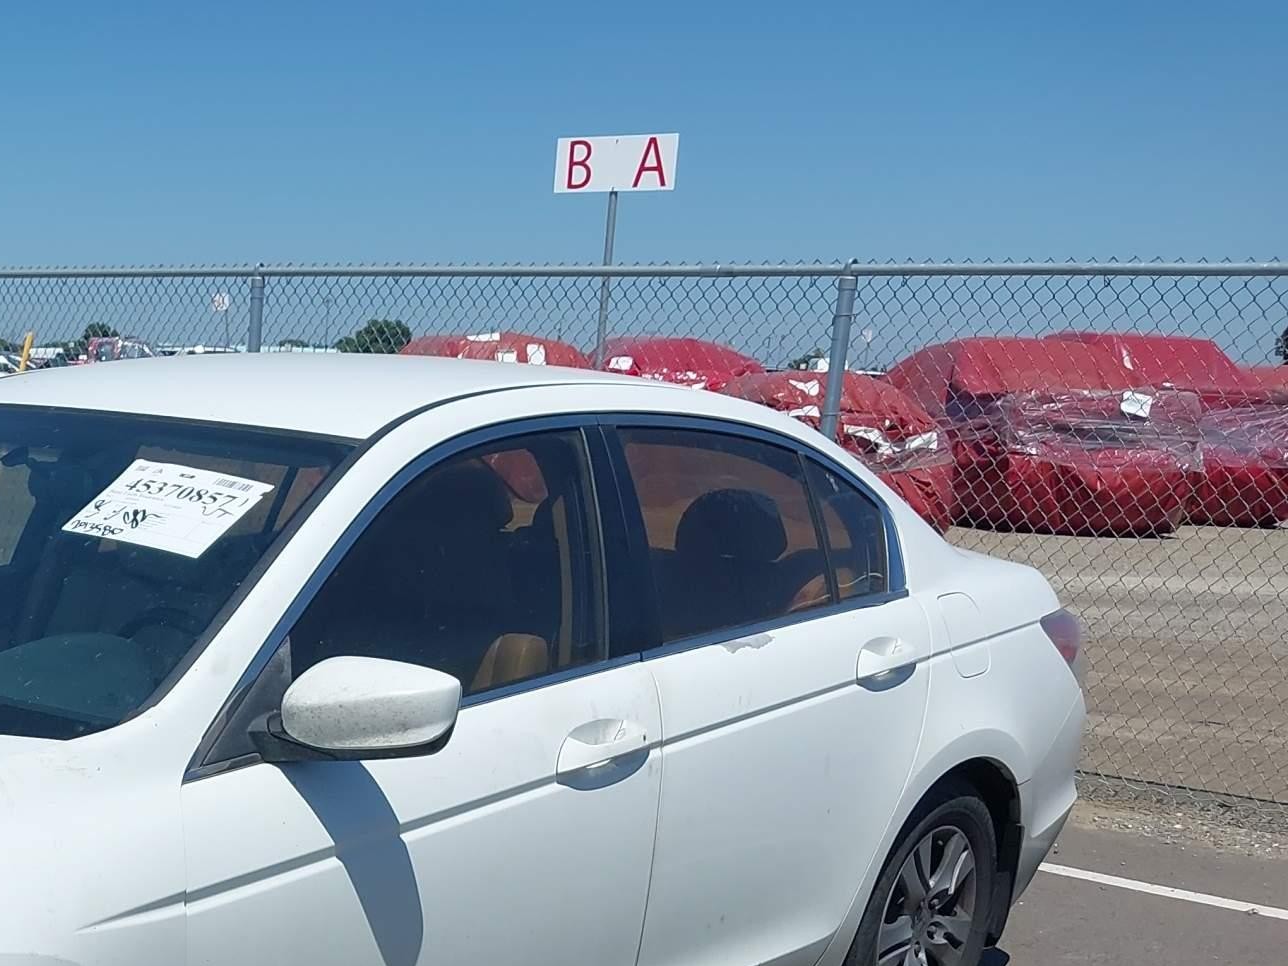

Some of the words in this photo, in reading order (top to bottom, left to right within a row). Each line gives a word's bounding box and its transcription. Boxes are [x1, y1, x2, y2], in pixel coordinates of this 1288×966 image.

[567, 140, 592, 190] B
[631, 137, 666, 188] A
[125, 478, 240, 508] 45370857
